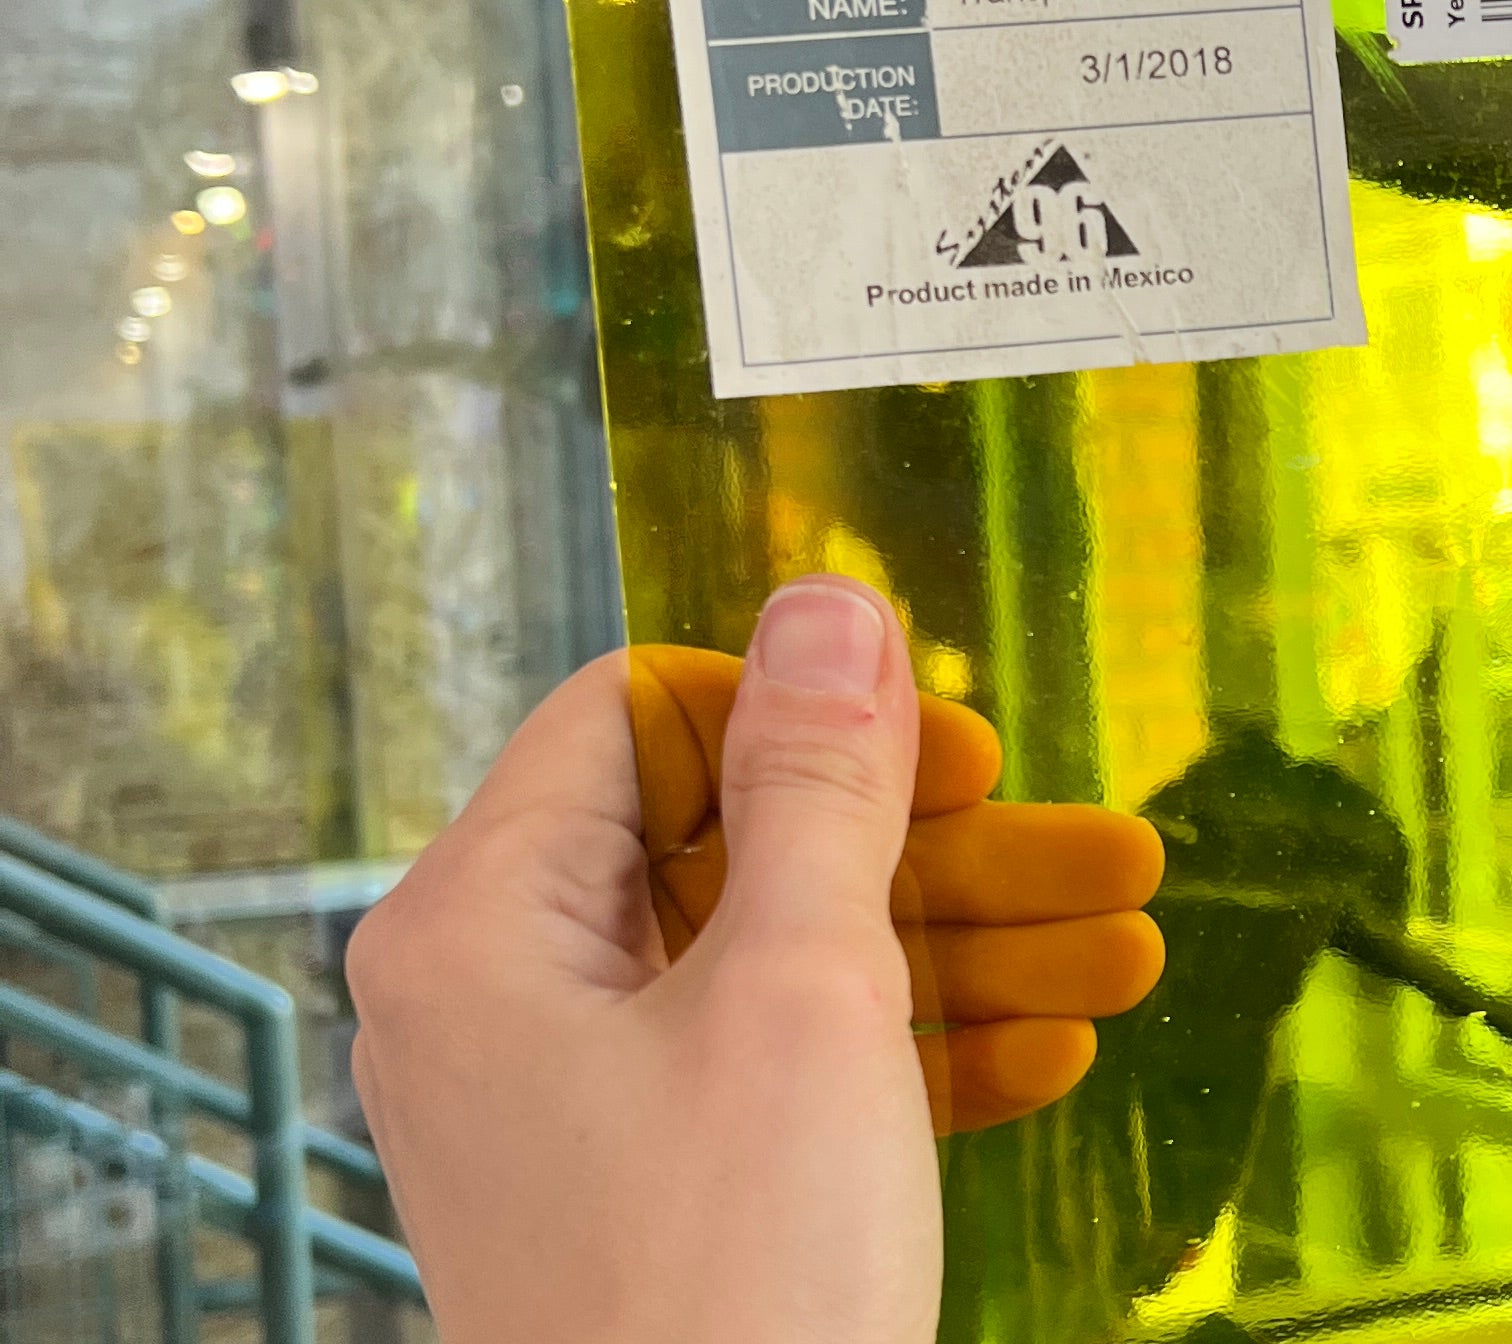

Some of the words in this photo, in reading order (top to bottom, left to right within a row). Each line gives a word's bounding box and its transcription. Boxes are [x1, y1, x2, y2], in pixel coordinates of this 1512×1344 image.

[746, 65, 916, 97] PRODUCTION
[1081, 46, 1234, 84] 3/1/2018
[846, 94, 920, 121] DATE:
[866, 279, 977, 308] Product
[984, 273, 1059, 299] made
[1067, 271, 1092, 293] in
[1101, 265, 1196, 290] Mexico
